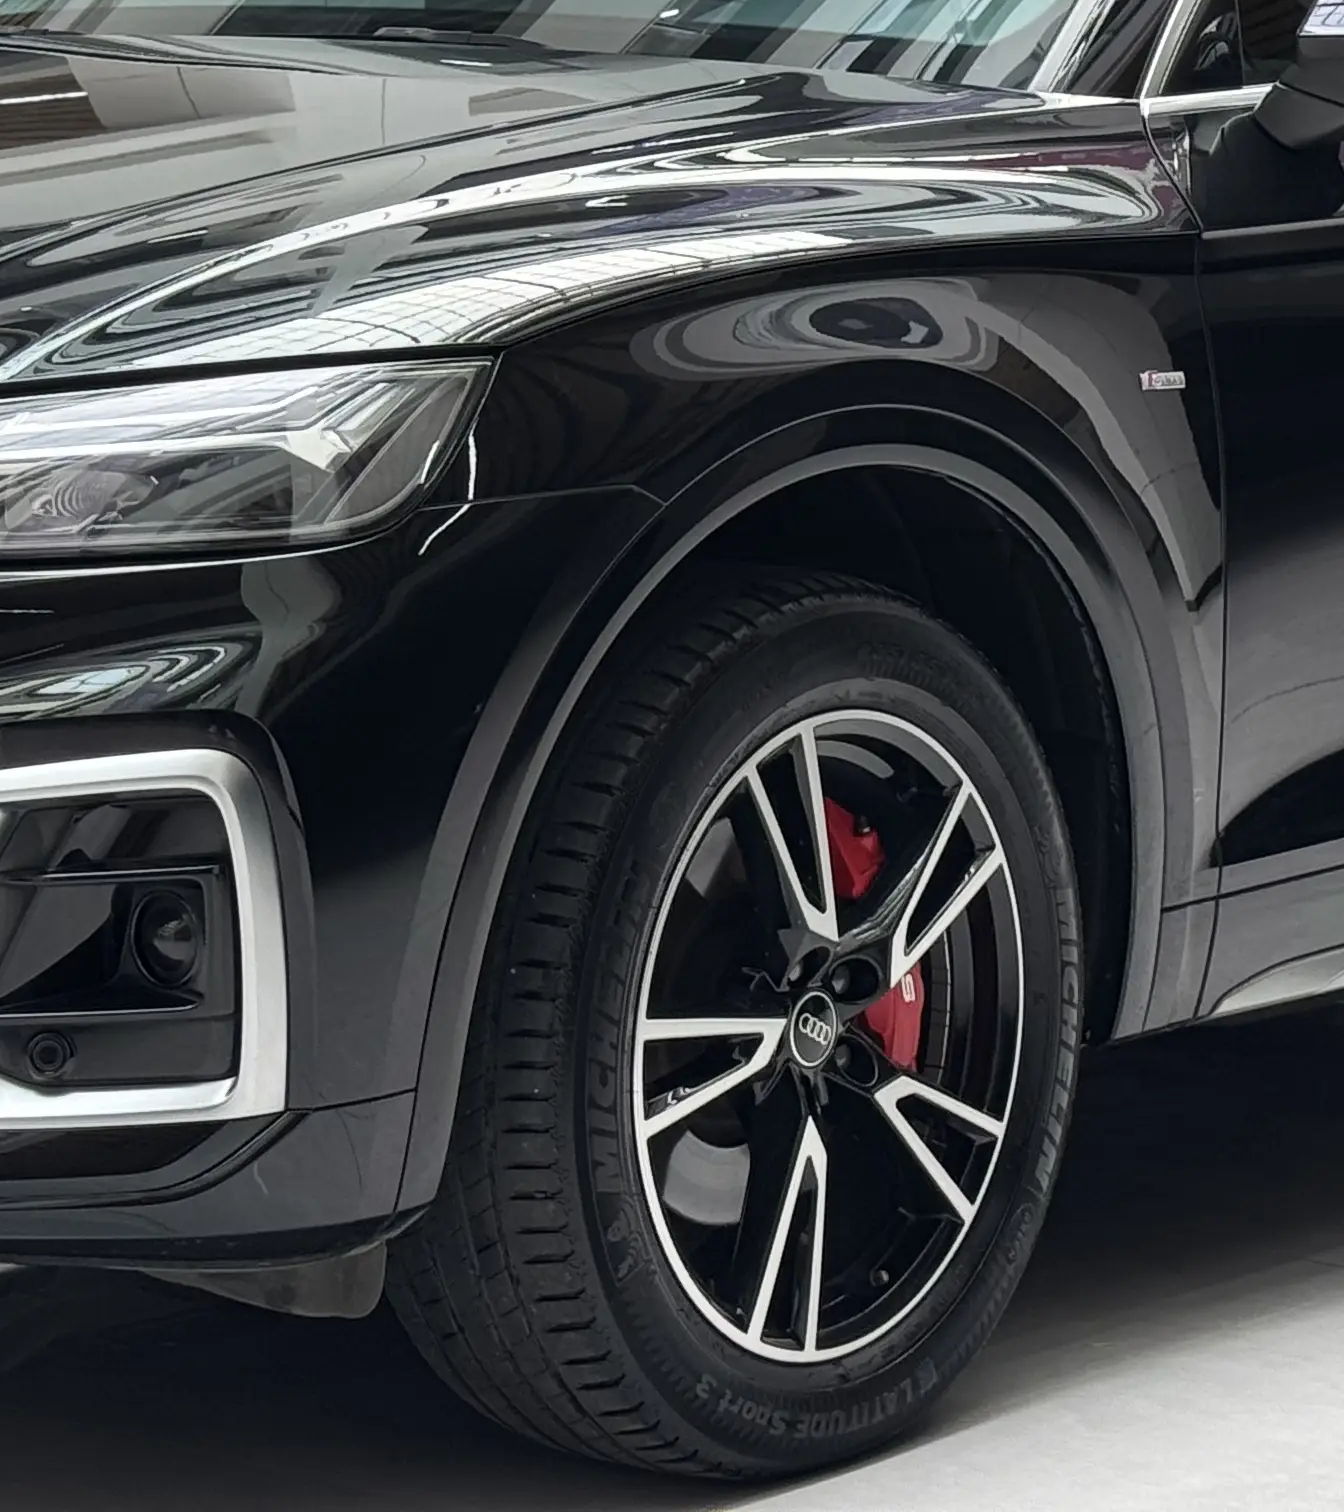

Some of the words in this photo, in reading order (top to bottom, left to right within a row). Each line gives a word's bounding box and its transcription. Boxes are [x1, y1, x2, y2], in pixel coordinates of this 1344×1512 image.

[1034, 885, 1079, 1192] MICHELIN
[696, 1373, 718, 1400] 3
[796, 1378, 913, 1439] LATITUDE
[718, 1391, 791, 1436] Sport
